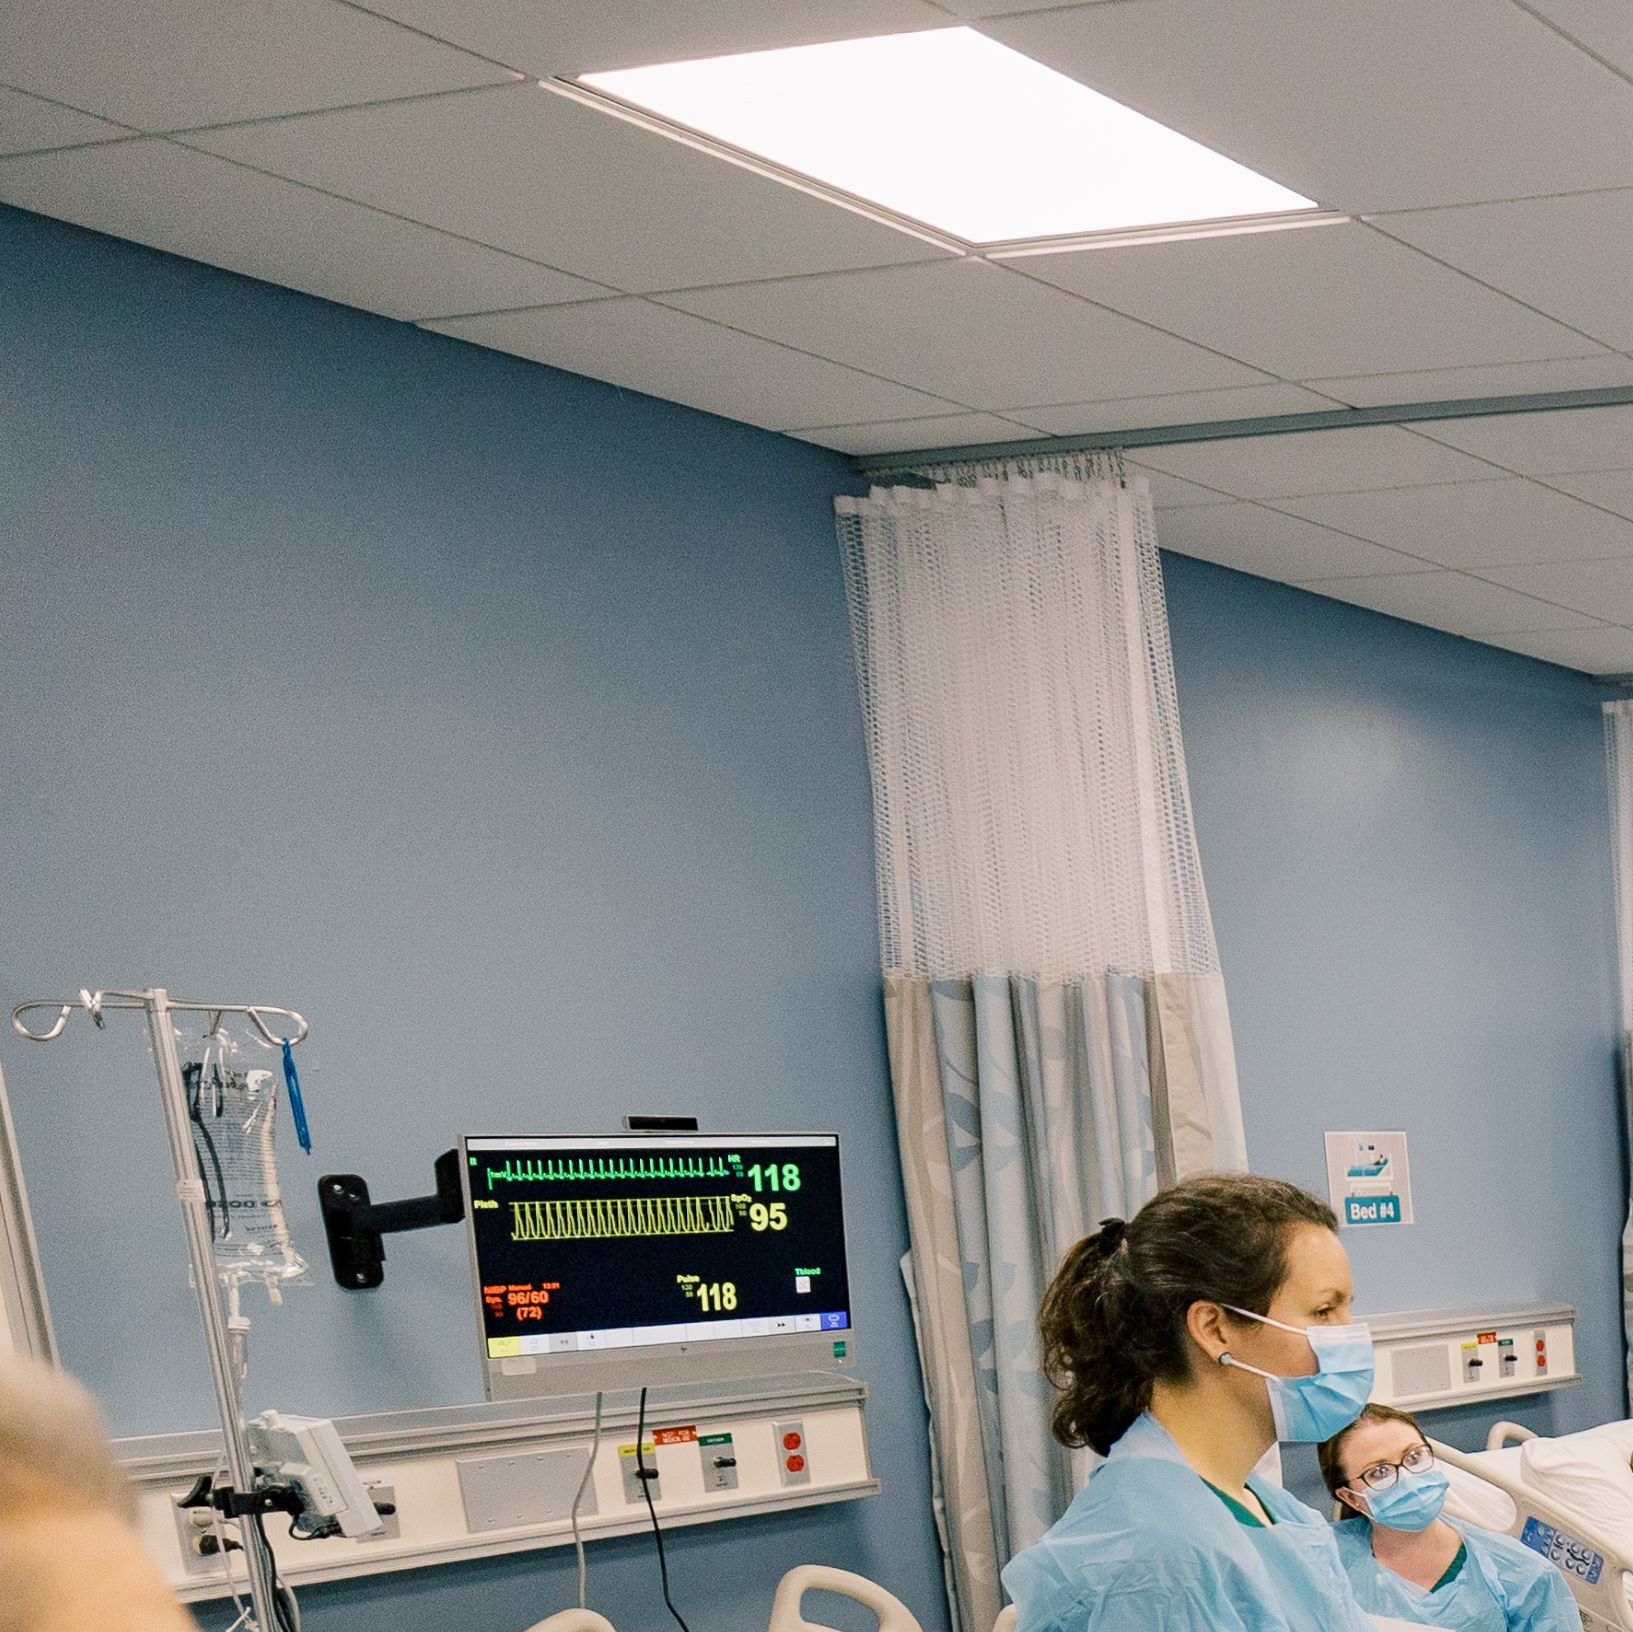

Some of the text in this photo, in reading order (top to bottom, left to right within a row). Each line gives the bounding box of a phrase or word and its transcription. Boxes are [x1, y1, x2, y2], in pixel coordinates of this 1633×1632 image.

[728, 1154, 741, 1163] HR
[748, 1164, 801, 1192] 118
[474, 1200, 499, 1209] Pleth
[1350, 1201, 1394, 1220] Bed #4
[750, 1202, 788, 1232] 95
[677, 1275, 700, 1283] Pulse
[508, 1290, 549, 1305] 96/60
[697, 1282, 738, 1312] 118
[516, 1306, 542, 1321] (72)
